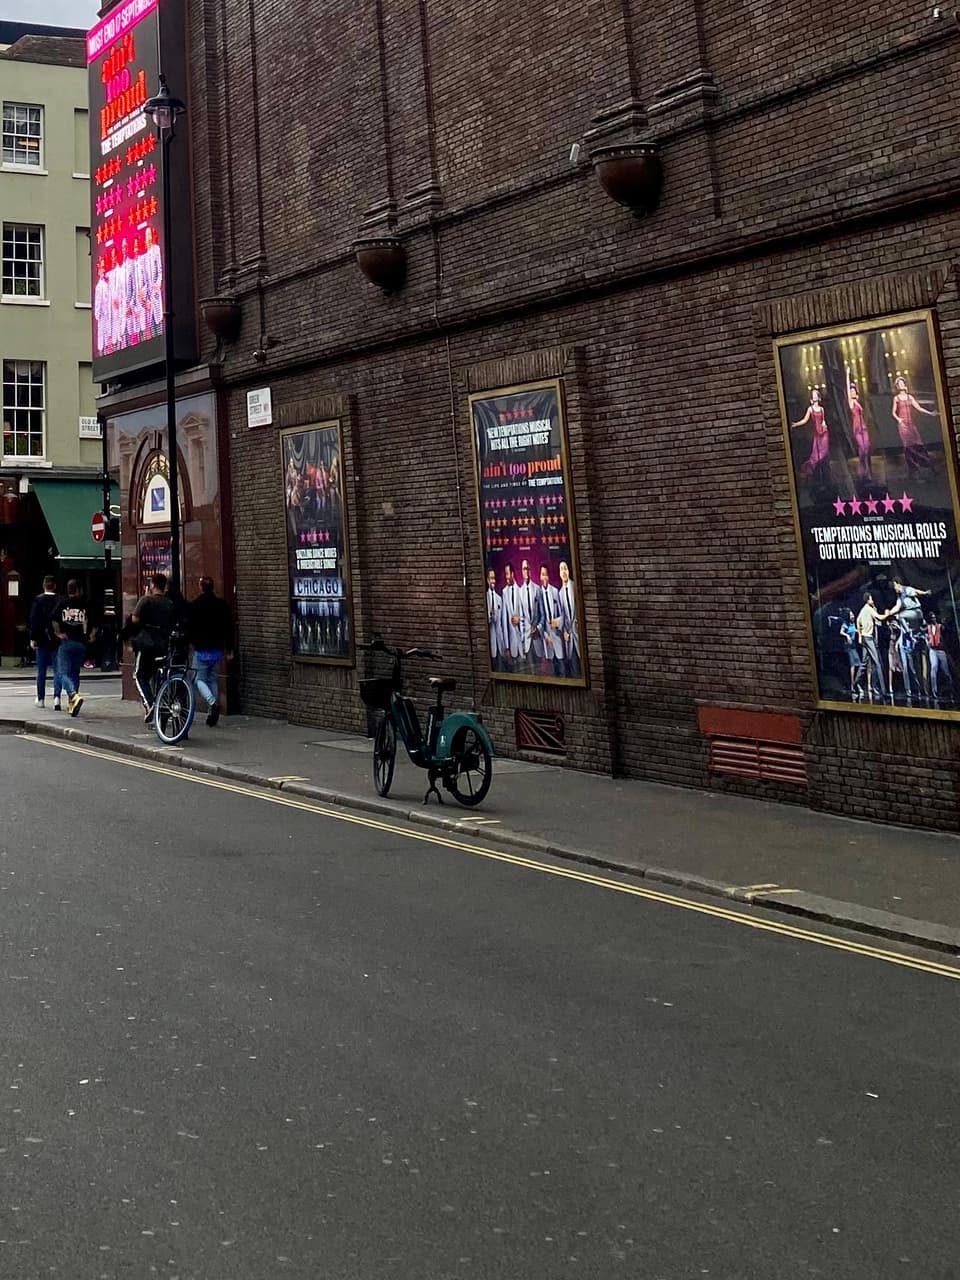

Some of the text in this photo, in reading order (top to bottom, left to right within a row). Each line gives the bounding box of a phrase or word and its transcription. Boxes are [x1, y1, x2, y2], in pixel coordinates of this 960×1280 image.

[89, 28, 104, 56] MUST
[103, 19, 115, 44] END
[106, 68, 130, 102] too
[101, 70, 146, 140] proud
[498, 421, 529, 437] TEMPTATIONS
[483, 453, 561, 478] ain't too proud
[811, 522, 947, 543] 'TEMPTATIONS MUSICAL ROLLS
[819, 540, 942, 559] OUT HIT AFTER MOTOWN HIT'
[297, 579, 339, 594] CHICAGO
